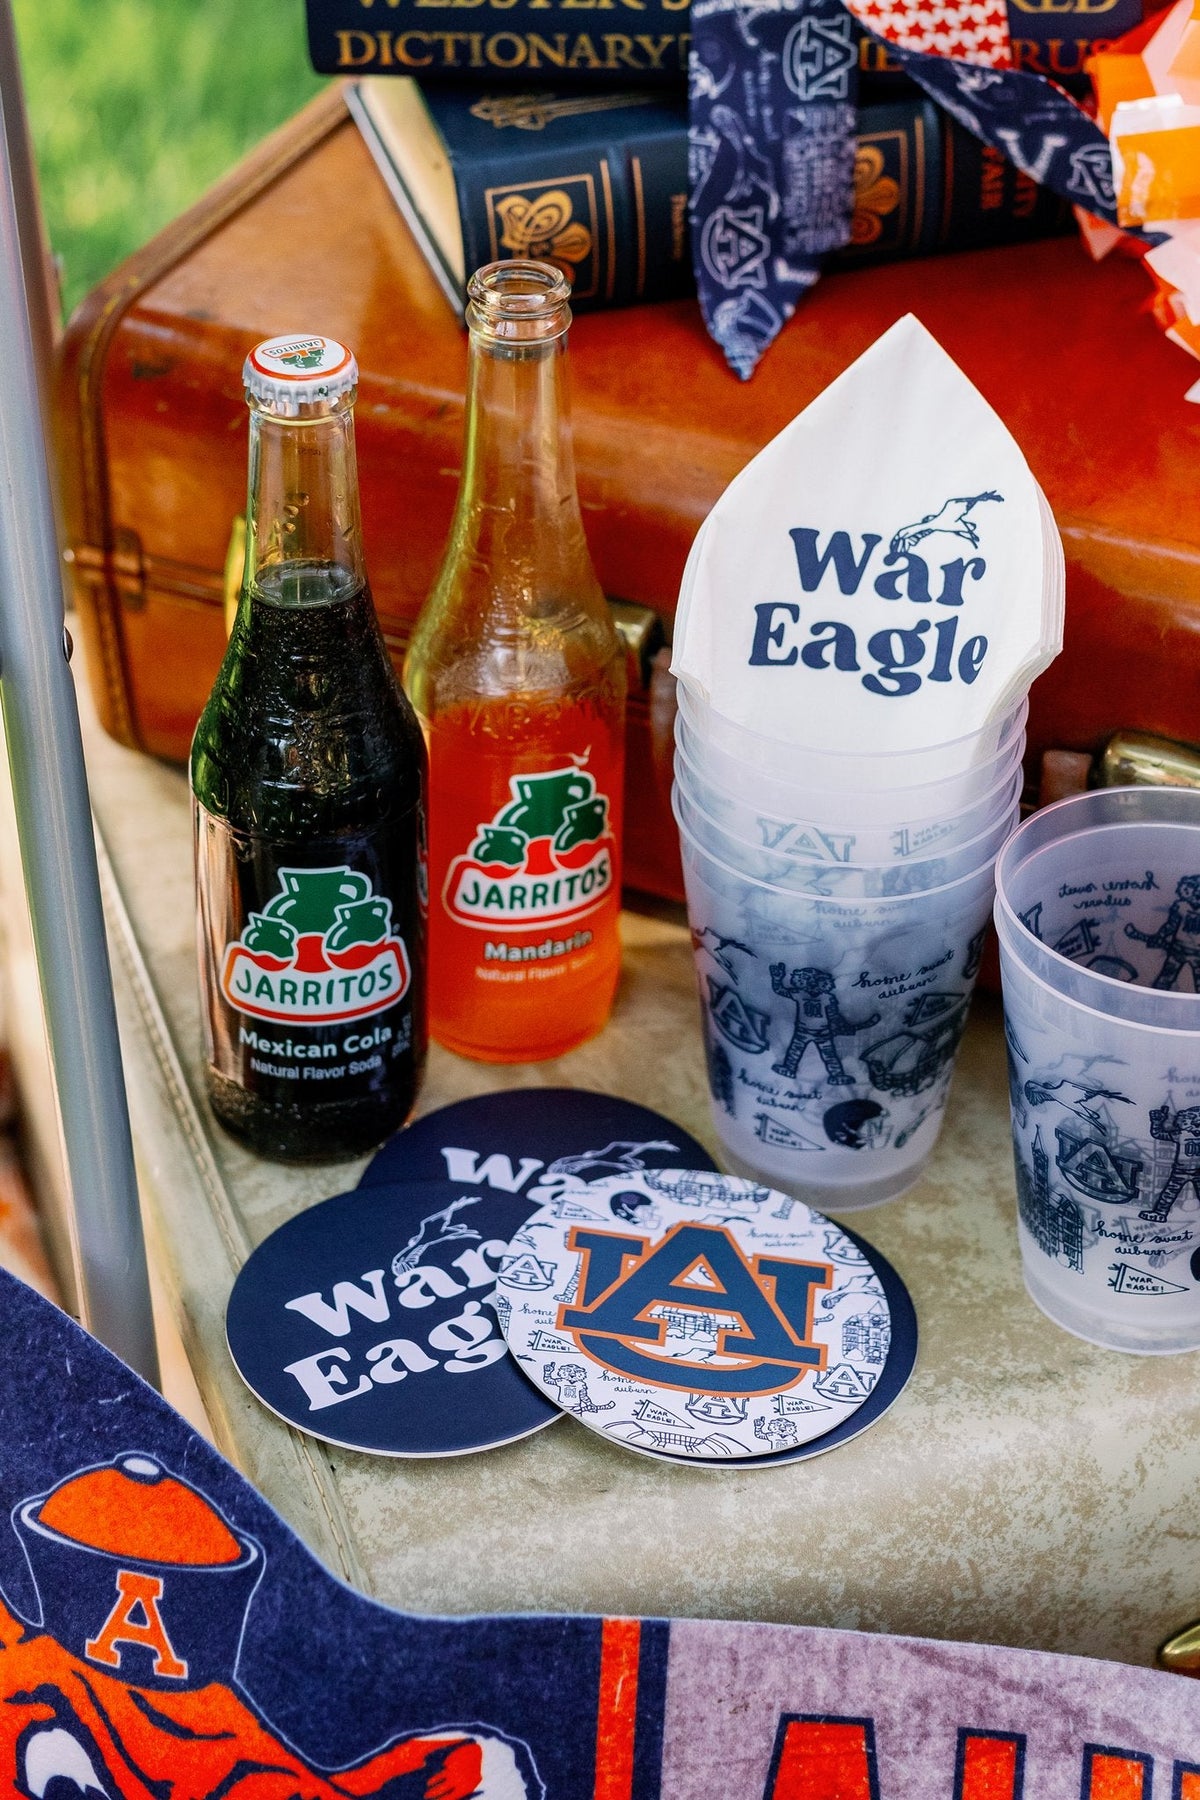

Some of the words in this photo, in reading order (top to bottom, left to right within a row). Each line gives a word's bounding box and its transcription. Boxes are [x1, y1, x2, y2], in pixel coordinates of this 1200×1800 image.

[334, 30, 675, 70] DICTIONARY
[268, 340, 320, 356] JARRITOS
[789, 527, 987, 606] War
[748, 602, 989, 697] Eagle
[461, 858, 609, 911] JARRITOS
[484, 930, 594, 962] Mandarin
[235, 963, 393, 1006] JARRITOS
[851, 971, 912, 989] home
[239, 1027, 338, 1058] Mexican
[343, 1026, 392, 1053] Cola
[251, 1057, 300, 1079] Natural
[303, 1064, 346, 1080] Flavor
[349, 1055, 382, 1075] Soda
[440, 1146, 587, 1205] Wa
[1091, 1220, 1146, 1244] home
[1149, 1229, 1194, 1244] sweet
[1114, 1246, 1175, 1256] auburn
[284, 1239, 510, 1338] War
[1126, 1283, 1165, 1293] EAGLE!
[1128, 1275, 1154, 1284] WAR
[518, 1303, 556, 1316] home
[534, 1316, 555, 1325] aub
[283, 1290, 509, 1411] Eag
[541, 1343, 571, 1351] EAGLE!
[543, 1337, 563, 1346] WAR
[598, 1370, 637, 1384] home
[614, 1384, 657, 1395] auburn
[646, 1414, 677, 1425] EAGLE!
[649, 1408, 669, 1417] WAR
[85, 1569, 189, 1680] A
